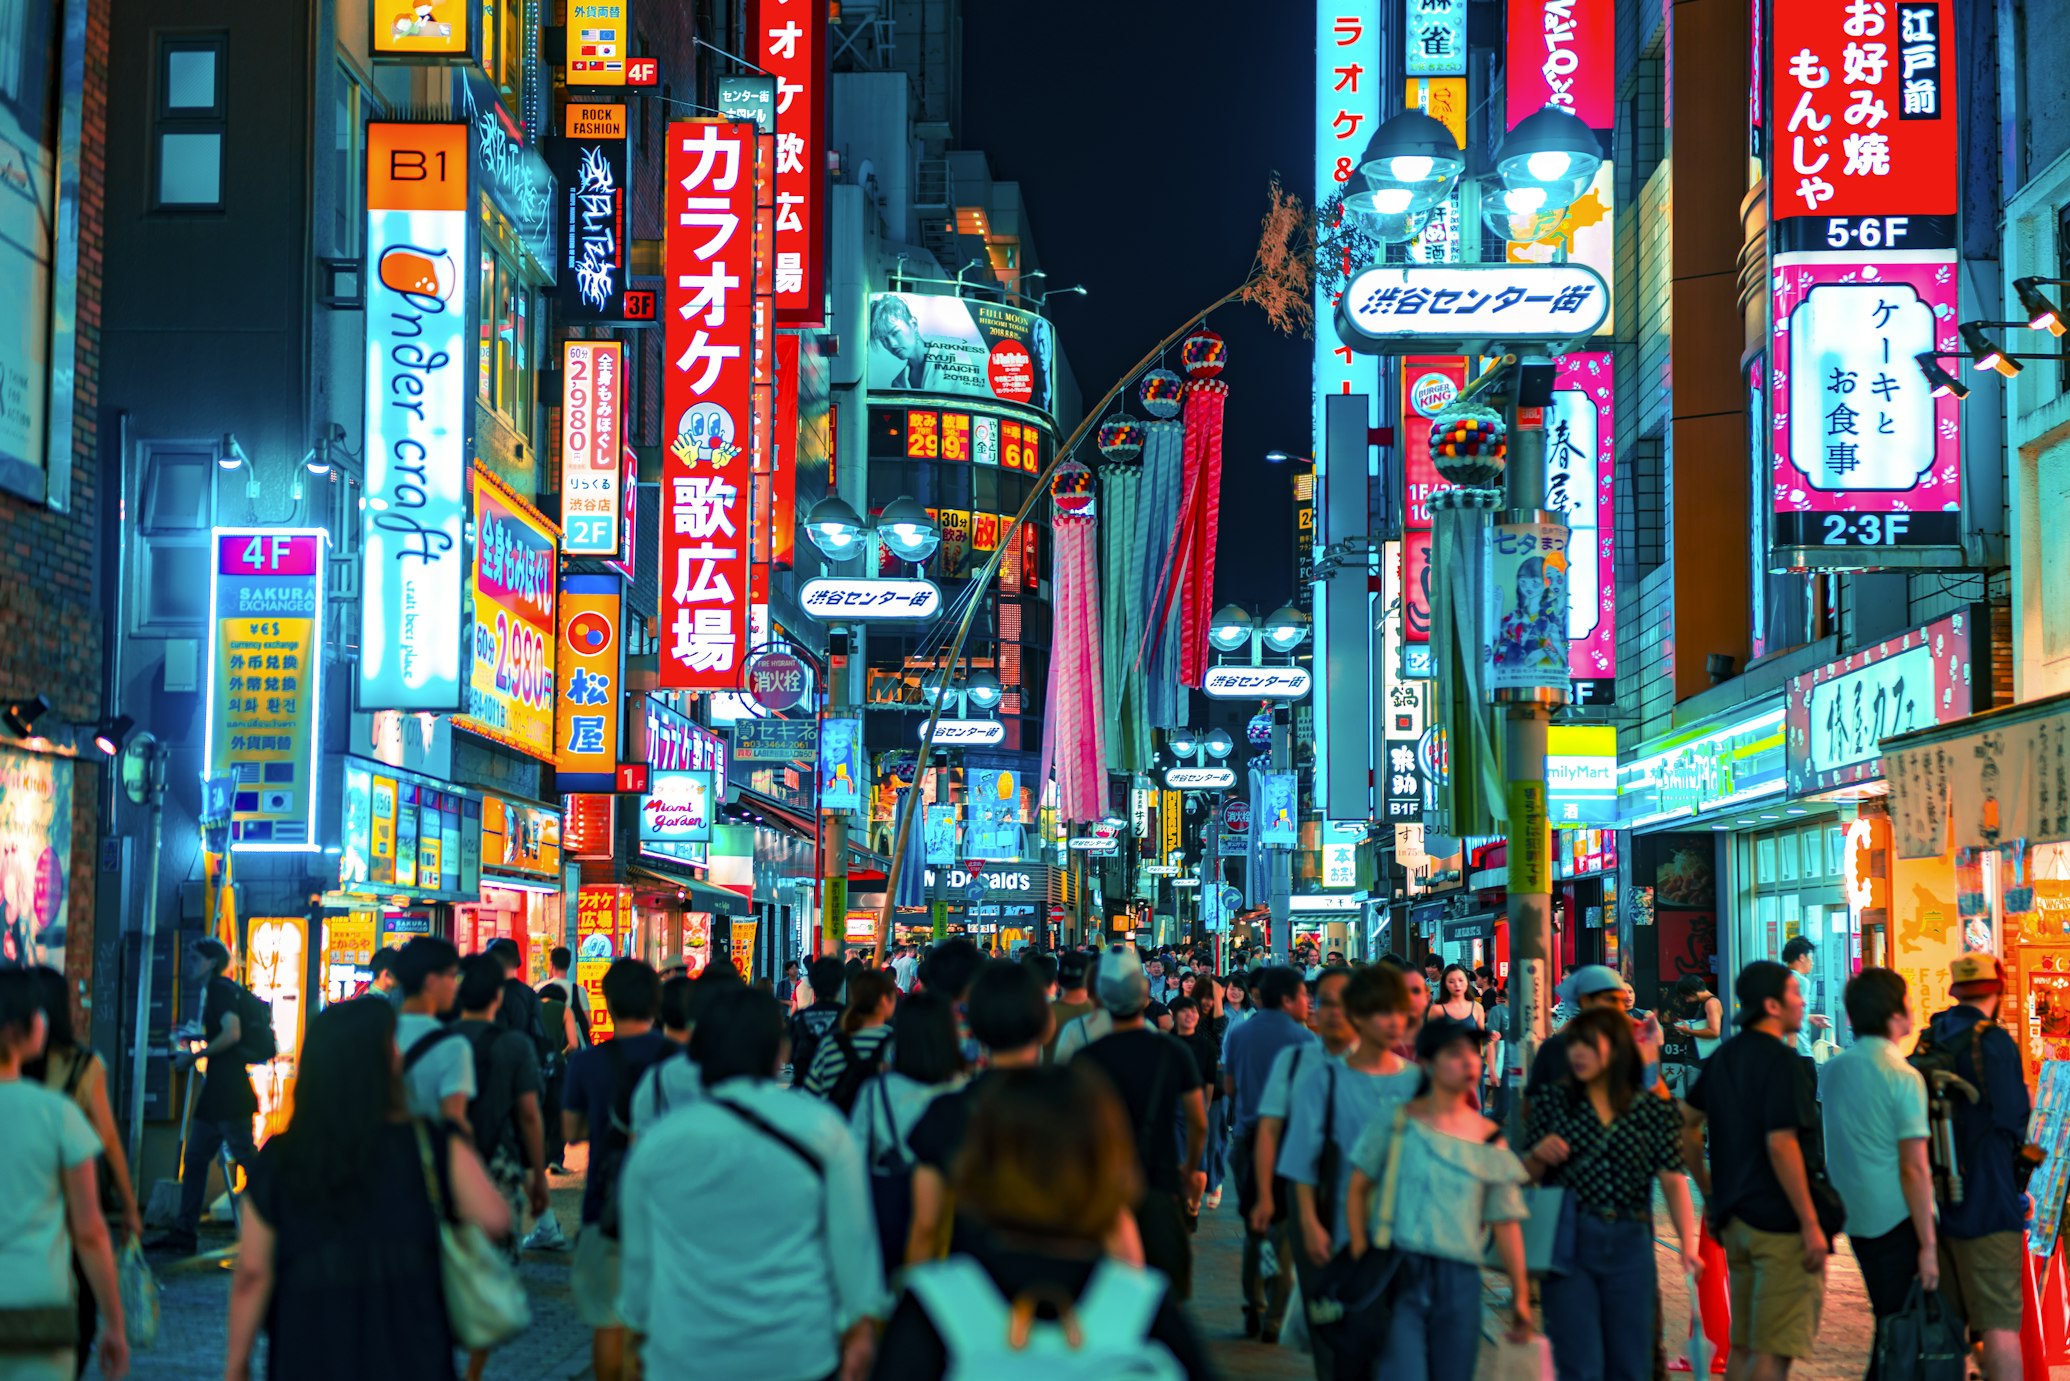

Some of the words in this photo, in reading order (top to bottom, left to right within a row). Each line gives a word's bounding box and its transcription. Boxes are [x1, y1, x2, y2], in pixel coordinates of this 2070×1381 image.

[574, 6, 620, 18] 外貨両替
[1901, 8, 1937, 115] 江戸前
[628, 63, 655, 81] 4F
[722, 89, 770, 103] センター街
[1842, 1, 1890, 177] お好み焼
[582, 109, 612, 121] ROCK
[573, 123, 620, 135] FASHION
[1787, 48, 1834, 211] もんじゃ
[768, 0, 805, 294] オケ歌広場
[390, 149, 447, 182] B1
[676, 126, 741, 396] カラオケ
[629, 295, 651, 315] 3F
[1358, 284, 1595, 315] 渋谷センター街
[979, 307, 1003, 320] FULL
[1005, 312, 1029, 326] MOON
[378, 243, 449, 421] Under
[569, 348, 588, 359] 60分
[1871, 299, 1901, 435] ケーキと
[943, 373, 986, 384] 2018.8.1
[1418, 383, 1450, 398] BURGER
[1420, 391, 1451, 408] KING
[596, 353, 614, 465] 全身もみほぐし
[1825, 367, 1861, 475] お食事
[570, 478, 611, 490] りらくる
[373, 438, 453, 566] craft
[569, 498, 611, 512] 渋谷店
[941, 512, 968, 528] 30分
[573, 521, 608, 543] 2F
[941, 529, 968, 543] 飲み
[973, 515, 996, 549] 放
[1494, 528, 1538, 556] 七夕
[242, 535, 291, 569] 4F
[481, 509, 552, 616] 全身もみほぐし
[671, 476, 738, 673] 歌広場
[240, 587, 315, 600] SAKURA
[806, 590, 933, 607] 渋谷センター街
[240, 600, 303, 611] EXCHANGE
[230, 641, 261, 651] currency
[263, 640, 299, 651] exchange
[476, 623, 496, 667] 60分
[753, 669, 802, 693] 消火栓
[1210, 675, 1306, 688] 渋谷センター街
[1391, 686, 1419, 708] 鍋
[565, 667, 610, 754] 松屋
[757, 721, 817, 741] セキネ
[231, 735, 291, 751] 外貨両替
[751, 740, 809, 749] 03-3464-2061
[622, 768, 645, 790] 1F
[1169, 773, 1231, 783] 渋谷センター街
[642, 799, 694, 813] Miami
[1390, 803, 1419, 815] B1F
[1563, 803, 1579, 819] 酒
[1135, 811, 1146, 836] 牛タン
[577, 910, 613, 928] 広場
[1936, 968, 1950, 1010] チー
